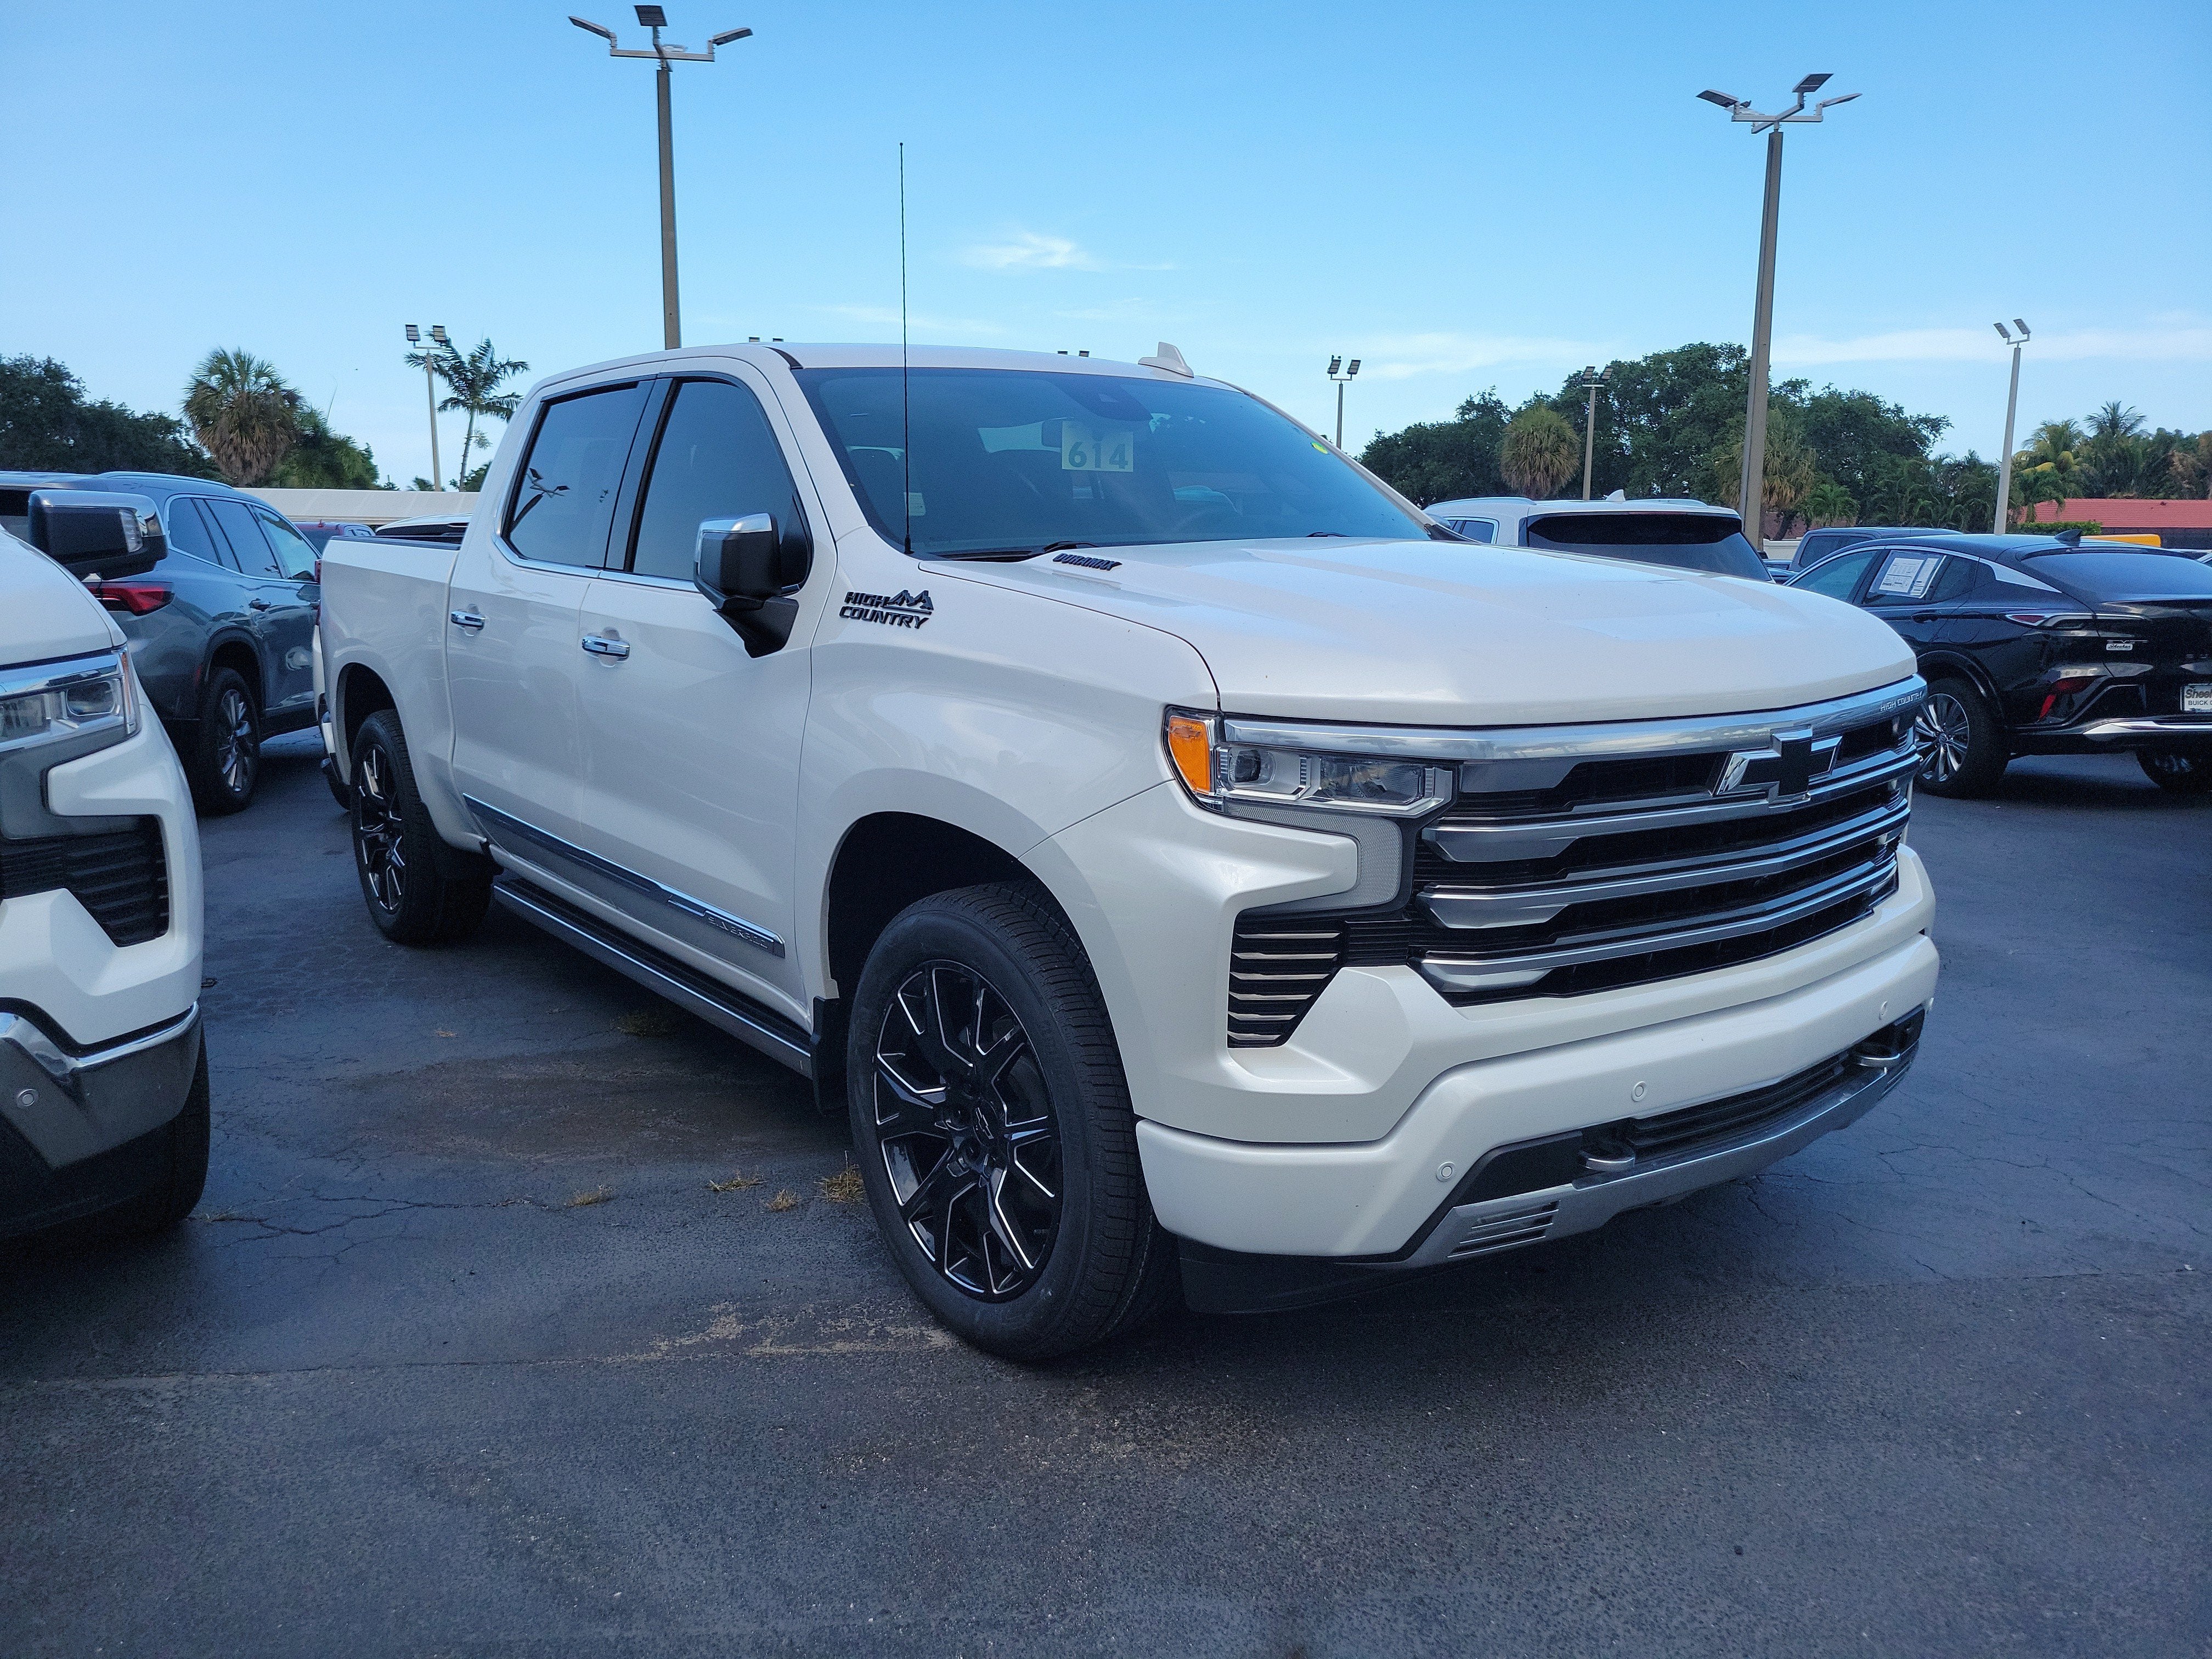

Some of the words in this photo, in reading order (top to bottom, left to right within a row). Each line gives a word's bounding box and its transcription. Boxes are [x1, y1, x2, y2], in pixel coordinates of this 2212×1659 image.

[1068, 441, 1128, 469] 614
[1052, 553, 1123, 571] DURAMAX
[844, 591, 891, 607] HIGH
[839, 606, 929, 629] COUNTRY
